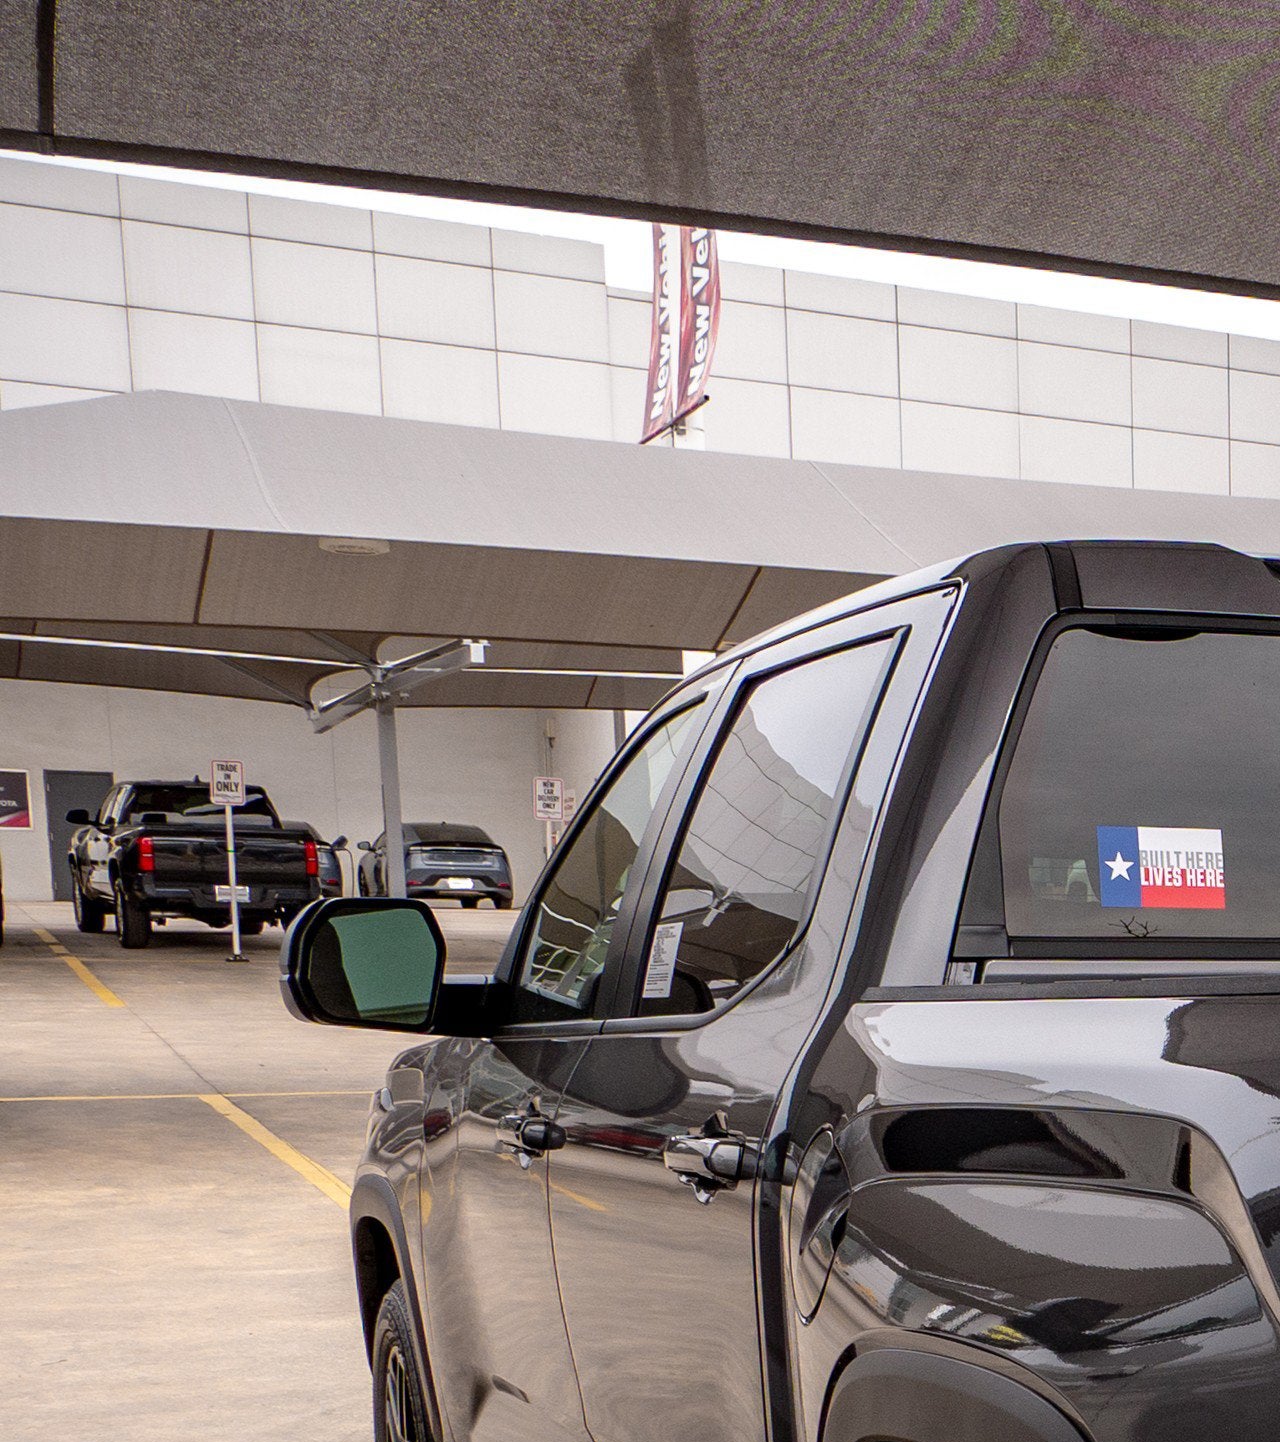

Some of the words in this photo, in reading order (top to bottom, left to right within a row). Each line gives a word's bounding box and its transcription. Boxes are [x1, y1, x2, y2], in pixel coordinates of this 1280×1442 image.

[687, 304, 710, 396] New
[651, 334, 671, 419] New
[216, 763, 238, 772] TRADE
[216, 781, 239, 792] ONLY
[1139, 850, 1181, 869] BUILT
[1186, 851, 1224, 870] HERE
[1140, 867, 1182, 887] LIVES
[1186, 869, 1225, 888] HERE
